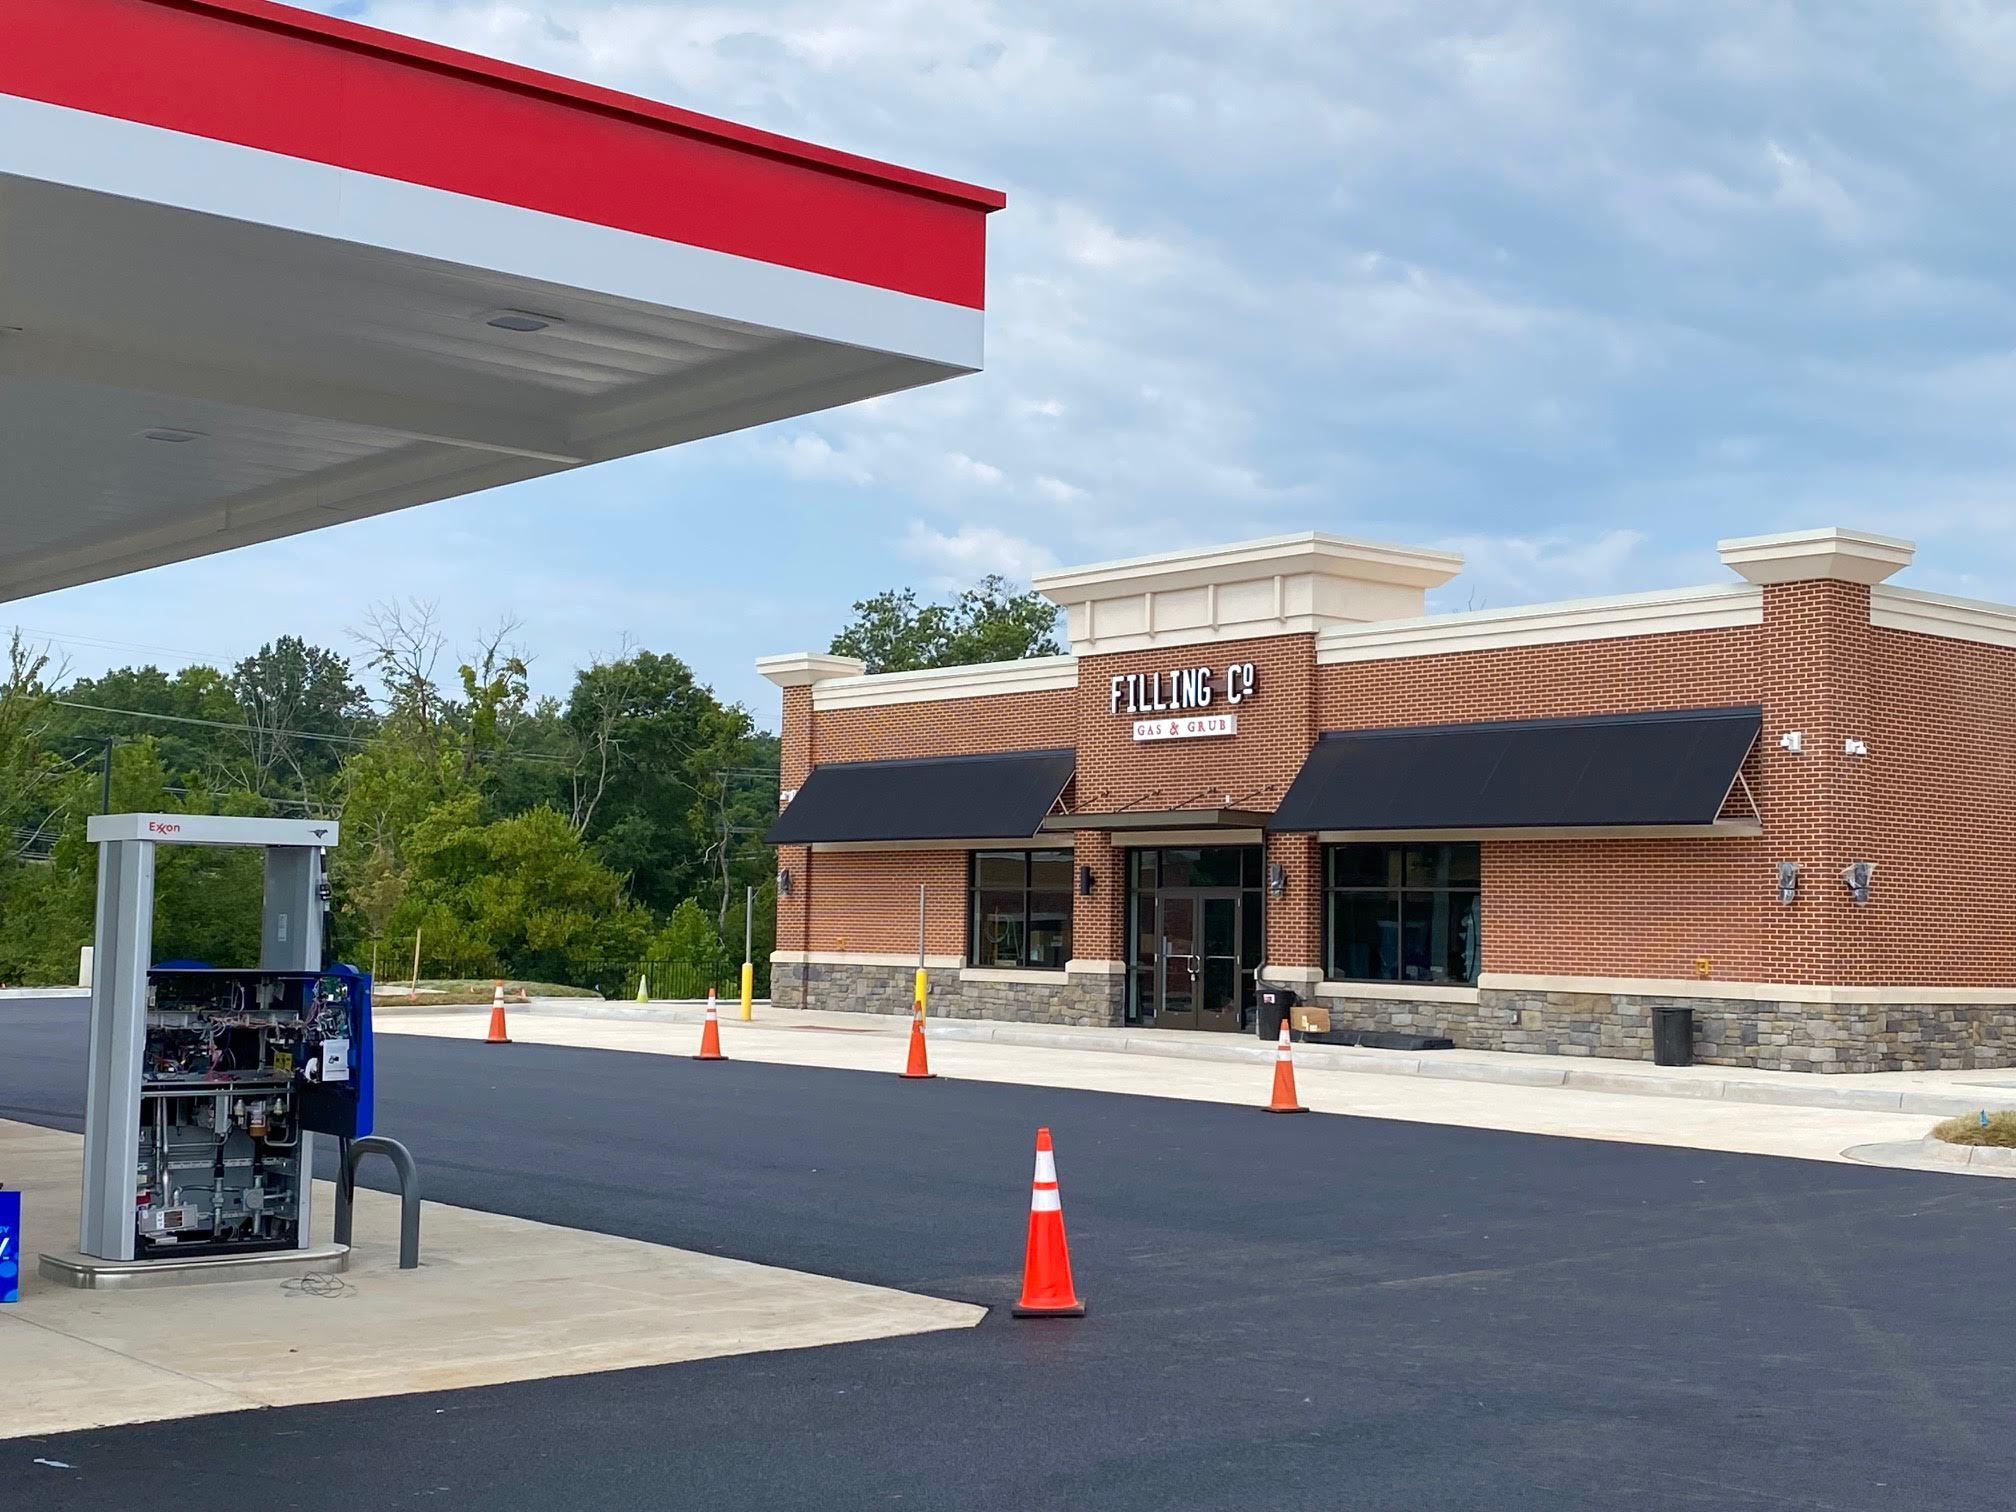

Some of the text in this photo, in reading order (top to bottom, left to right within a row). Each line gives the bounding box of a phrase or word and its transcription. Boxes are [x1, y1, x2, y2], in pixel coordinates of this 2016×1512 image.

[1111, 667, 1211, 713] FILLING
[1137, 719, 1227, 736] GAS & GRUB
[149, 822, 180, 835] Exxon
